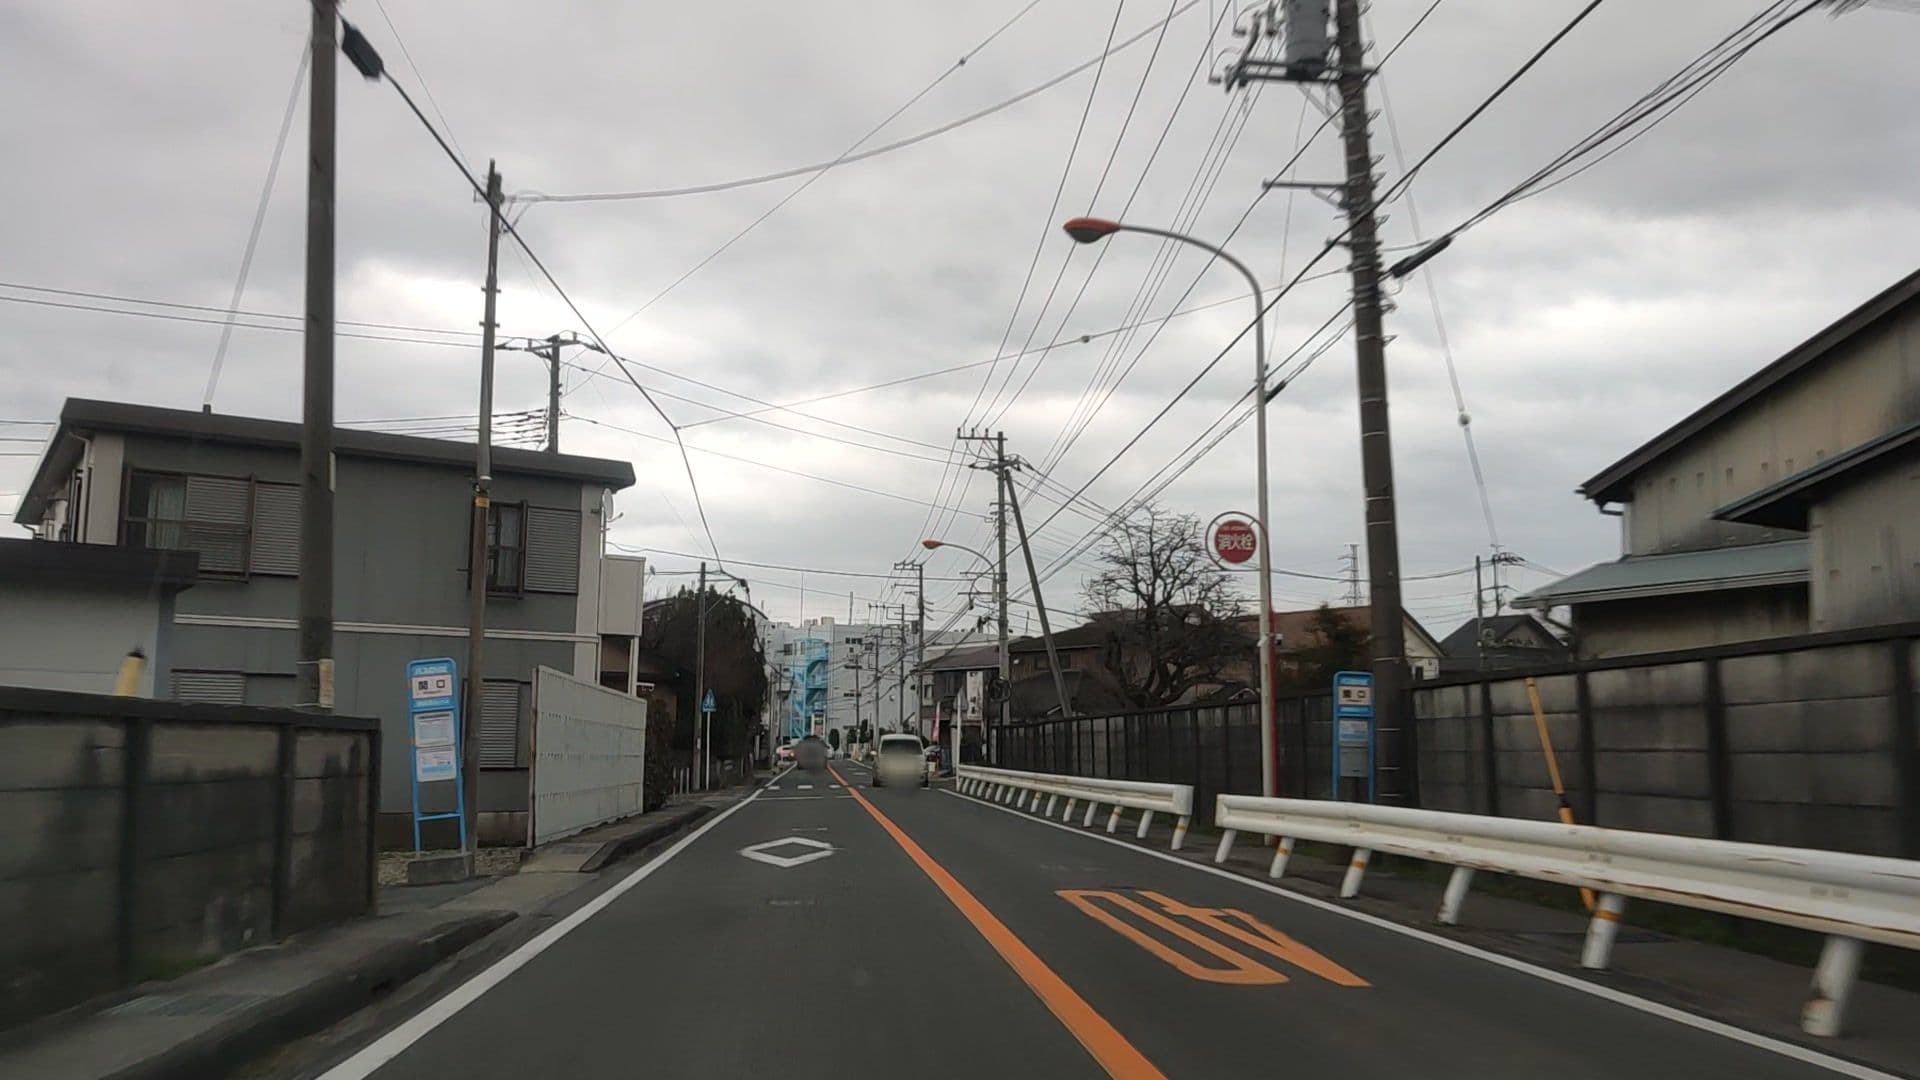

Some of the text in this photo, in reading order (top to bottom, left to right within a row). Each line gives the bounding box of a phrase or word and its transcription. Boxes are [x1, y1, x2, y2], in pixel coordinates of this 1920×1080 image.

[1218, 533, 1254, 550] 消火栓
[1054, 888, 1373, 987] 40
